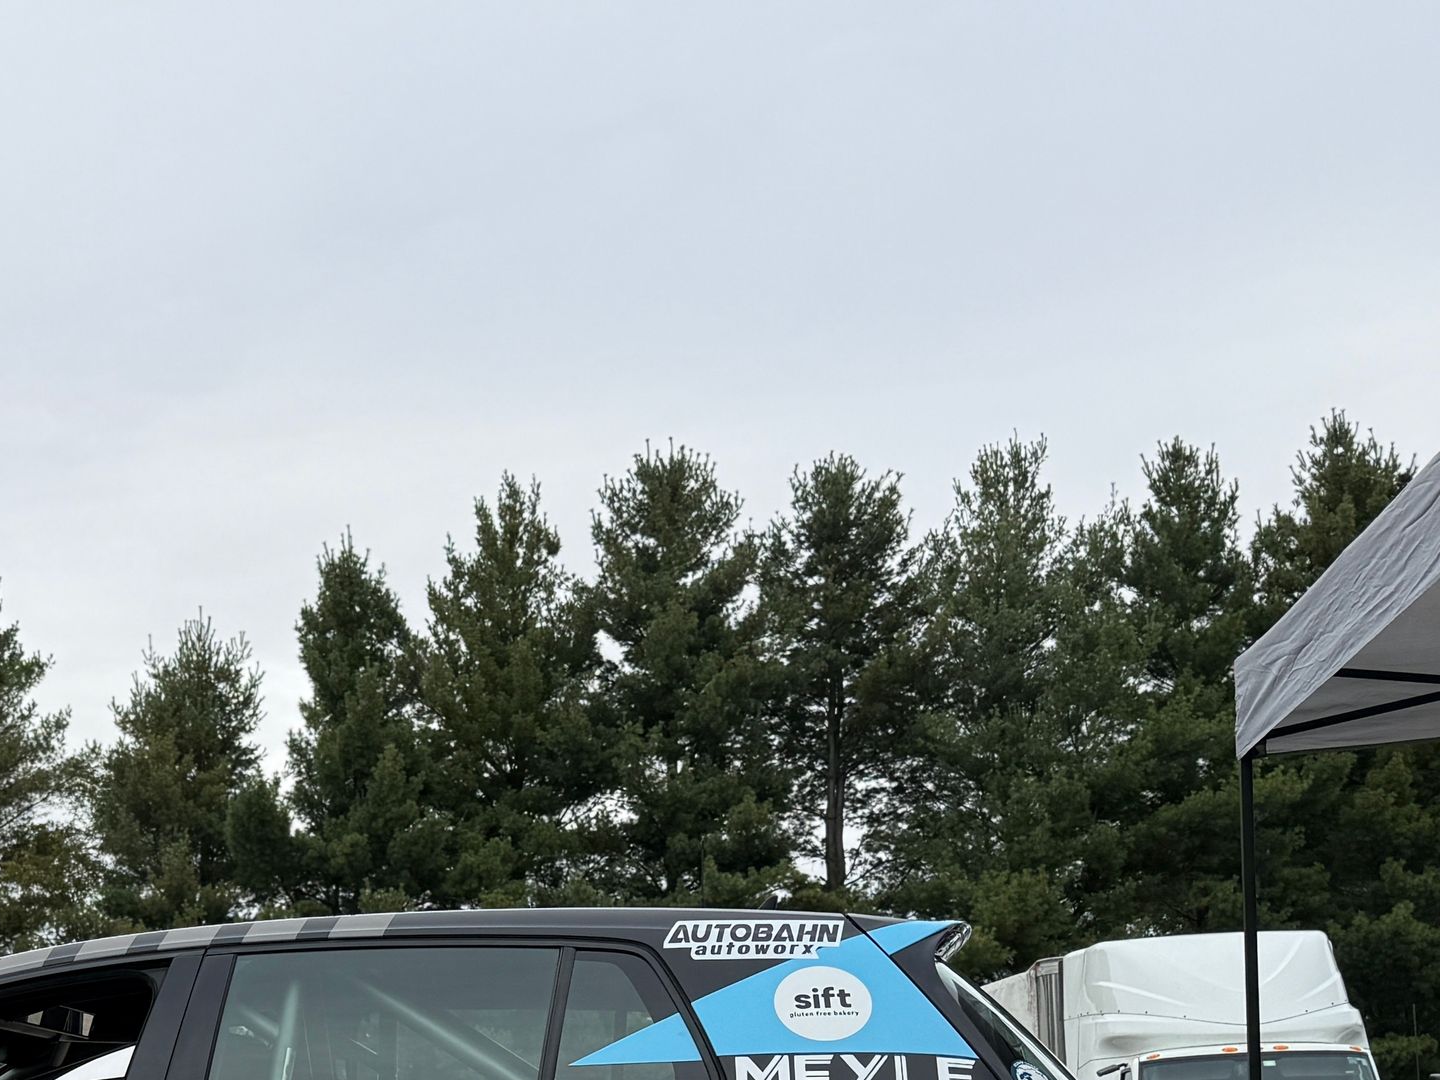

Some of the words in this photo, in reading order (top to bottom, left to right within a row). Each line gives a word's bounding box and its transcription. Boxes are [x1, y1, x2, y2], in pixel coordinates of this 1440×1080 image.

[668, 923, 840, 944] AUTOBAHN
[694, 942, 814, 956] autoworx
[794, 986, 852, 1010] sift
[789, 1010, 814, 1018] gluten
